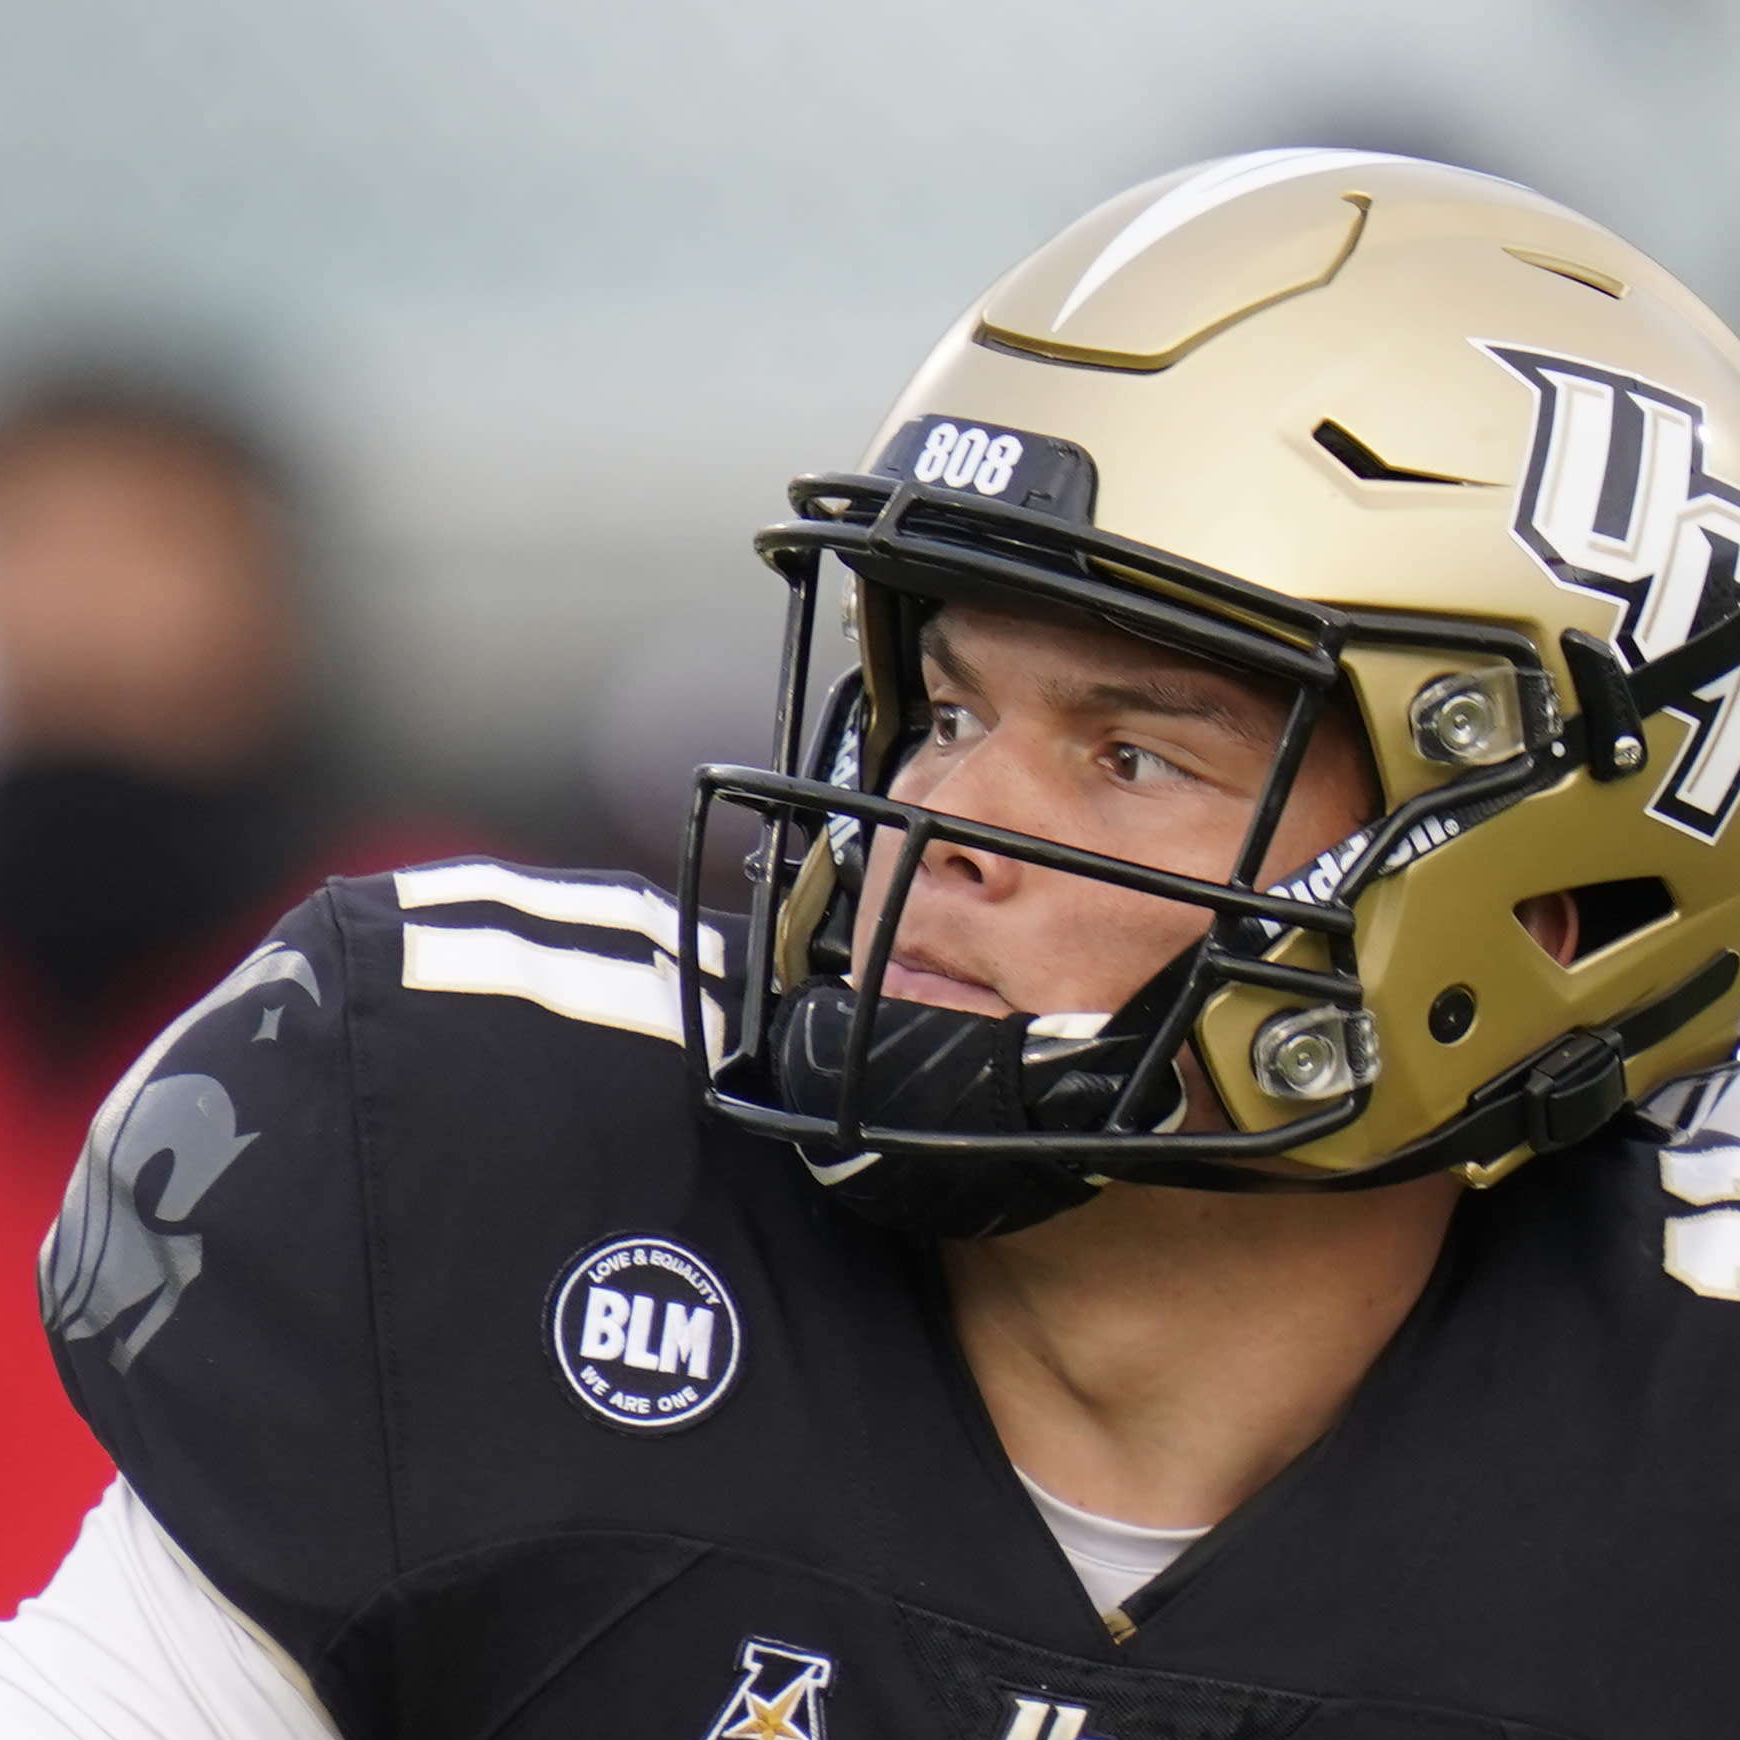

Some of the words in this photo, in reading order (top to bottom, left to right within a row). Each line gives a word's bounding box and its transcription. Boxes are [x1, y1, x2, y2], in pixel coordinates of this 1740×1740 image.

[914, 422, 1024, 496] 808
[588, 1251, 632, 1284] LOVE
[632, 1248, 649, 1266] &
[649, 1249, 722, 1306] EQUALITY
[580, 1285, 715, 1381] BLM
[580, 1364, 610, 1397] WE
[608, 1391, 651, 1414] ARE
[657, 1385, 699, 1413] ONE
